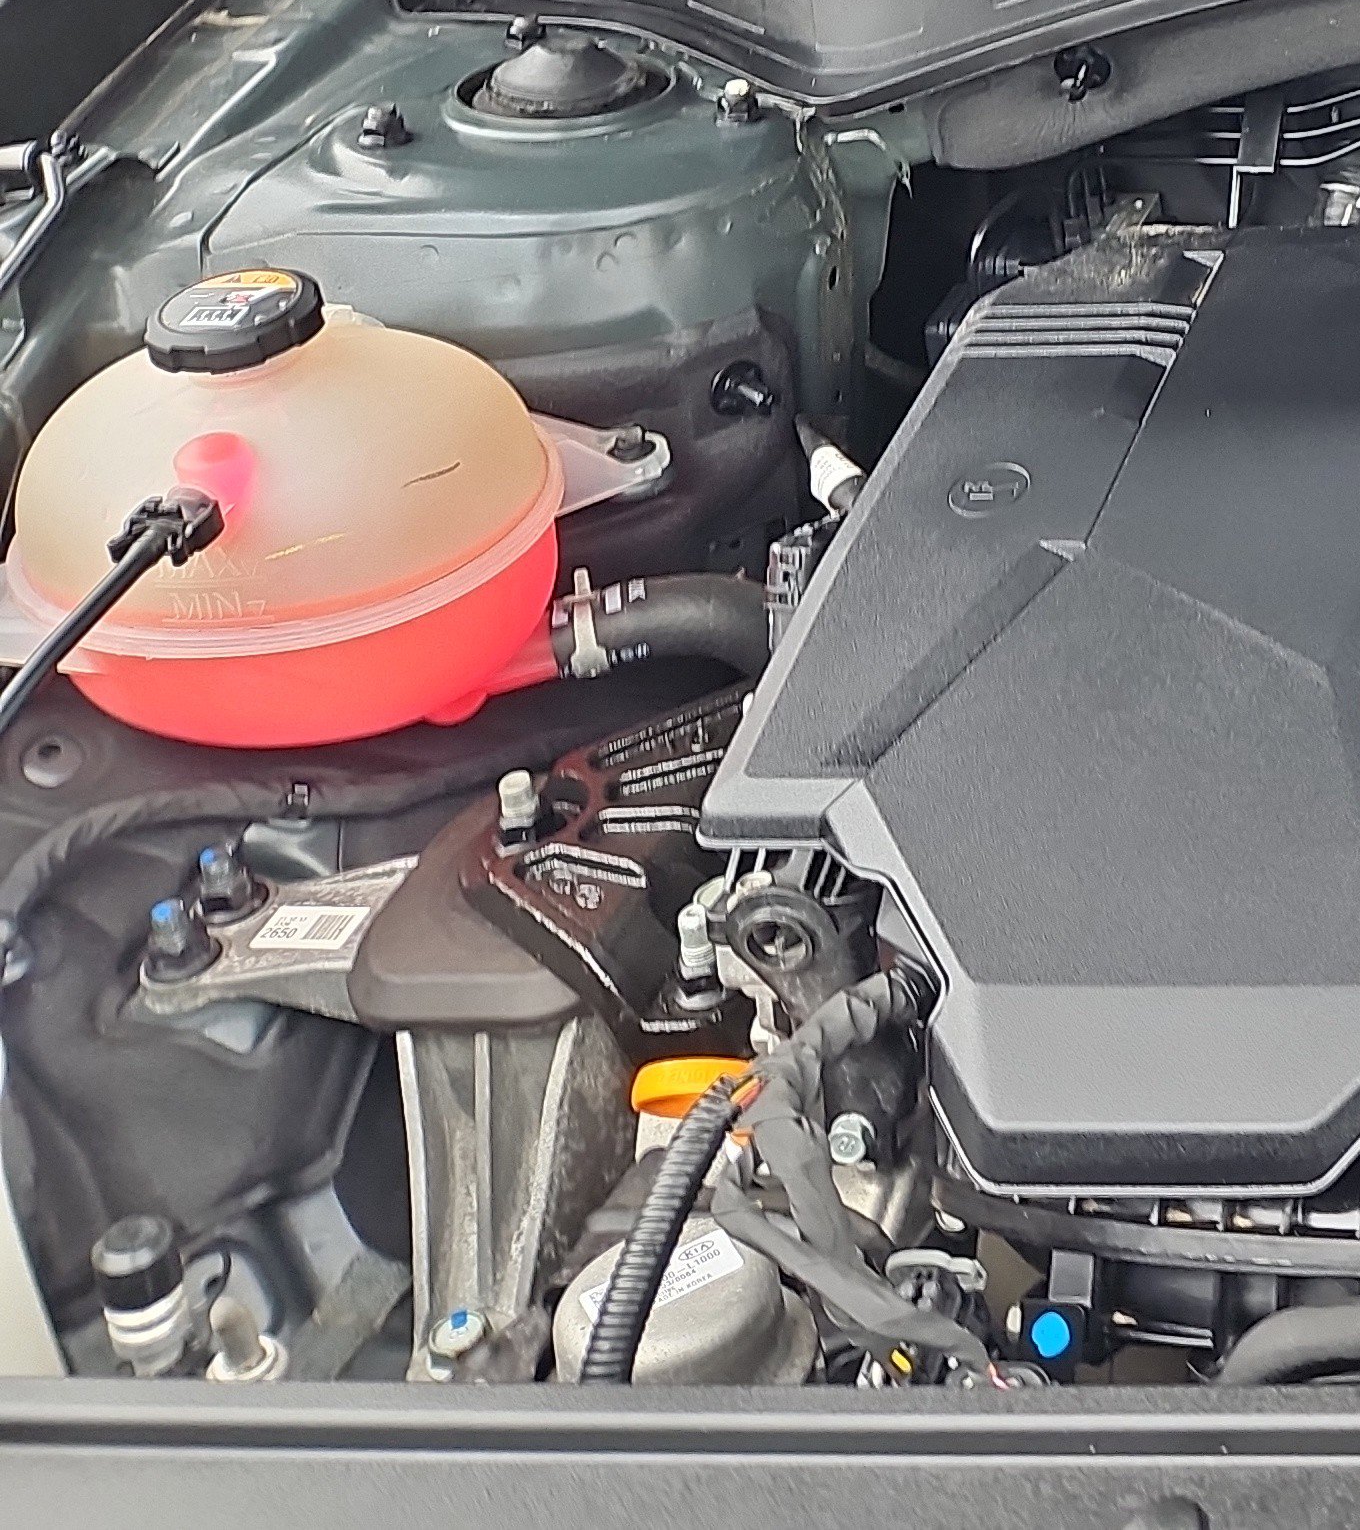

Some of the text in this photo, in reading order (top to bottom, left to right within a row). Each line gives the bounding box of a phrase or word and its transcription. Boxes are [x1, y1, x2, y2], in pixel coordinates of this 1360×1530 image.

[169, 591, 243, 621] MIN
[260, 927, 298, 939] 2650
[683, 1242, 711, 1260] KIA
